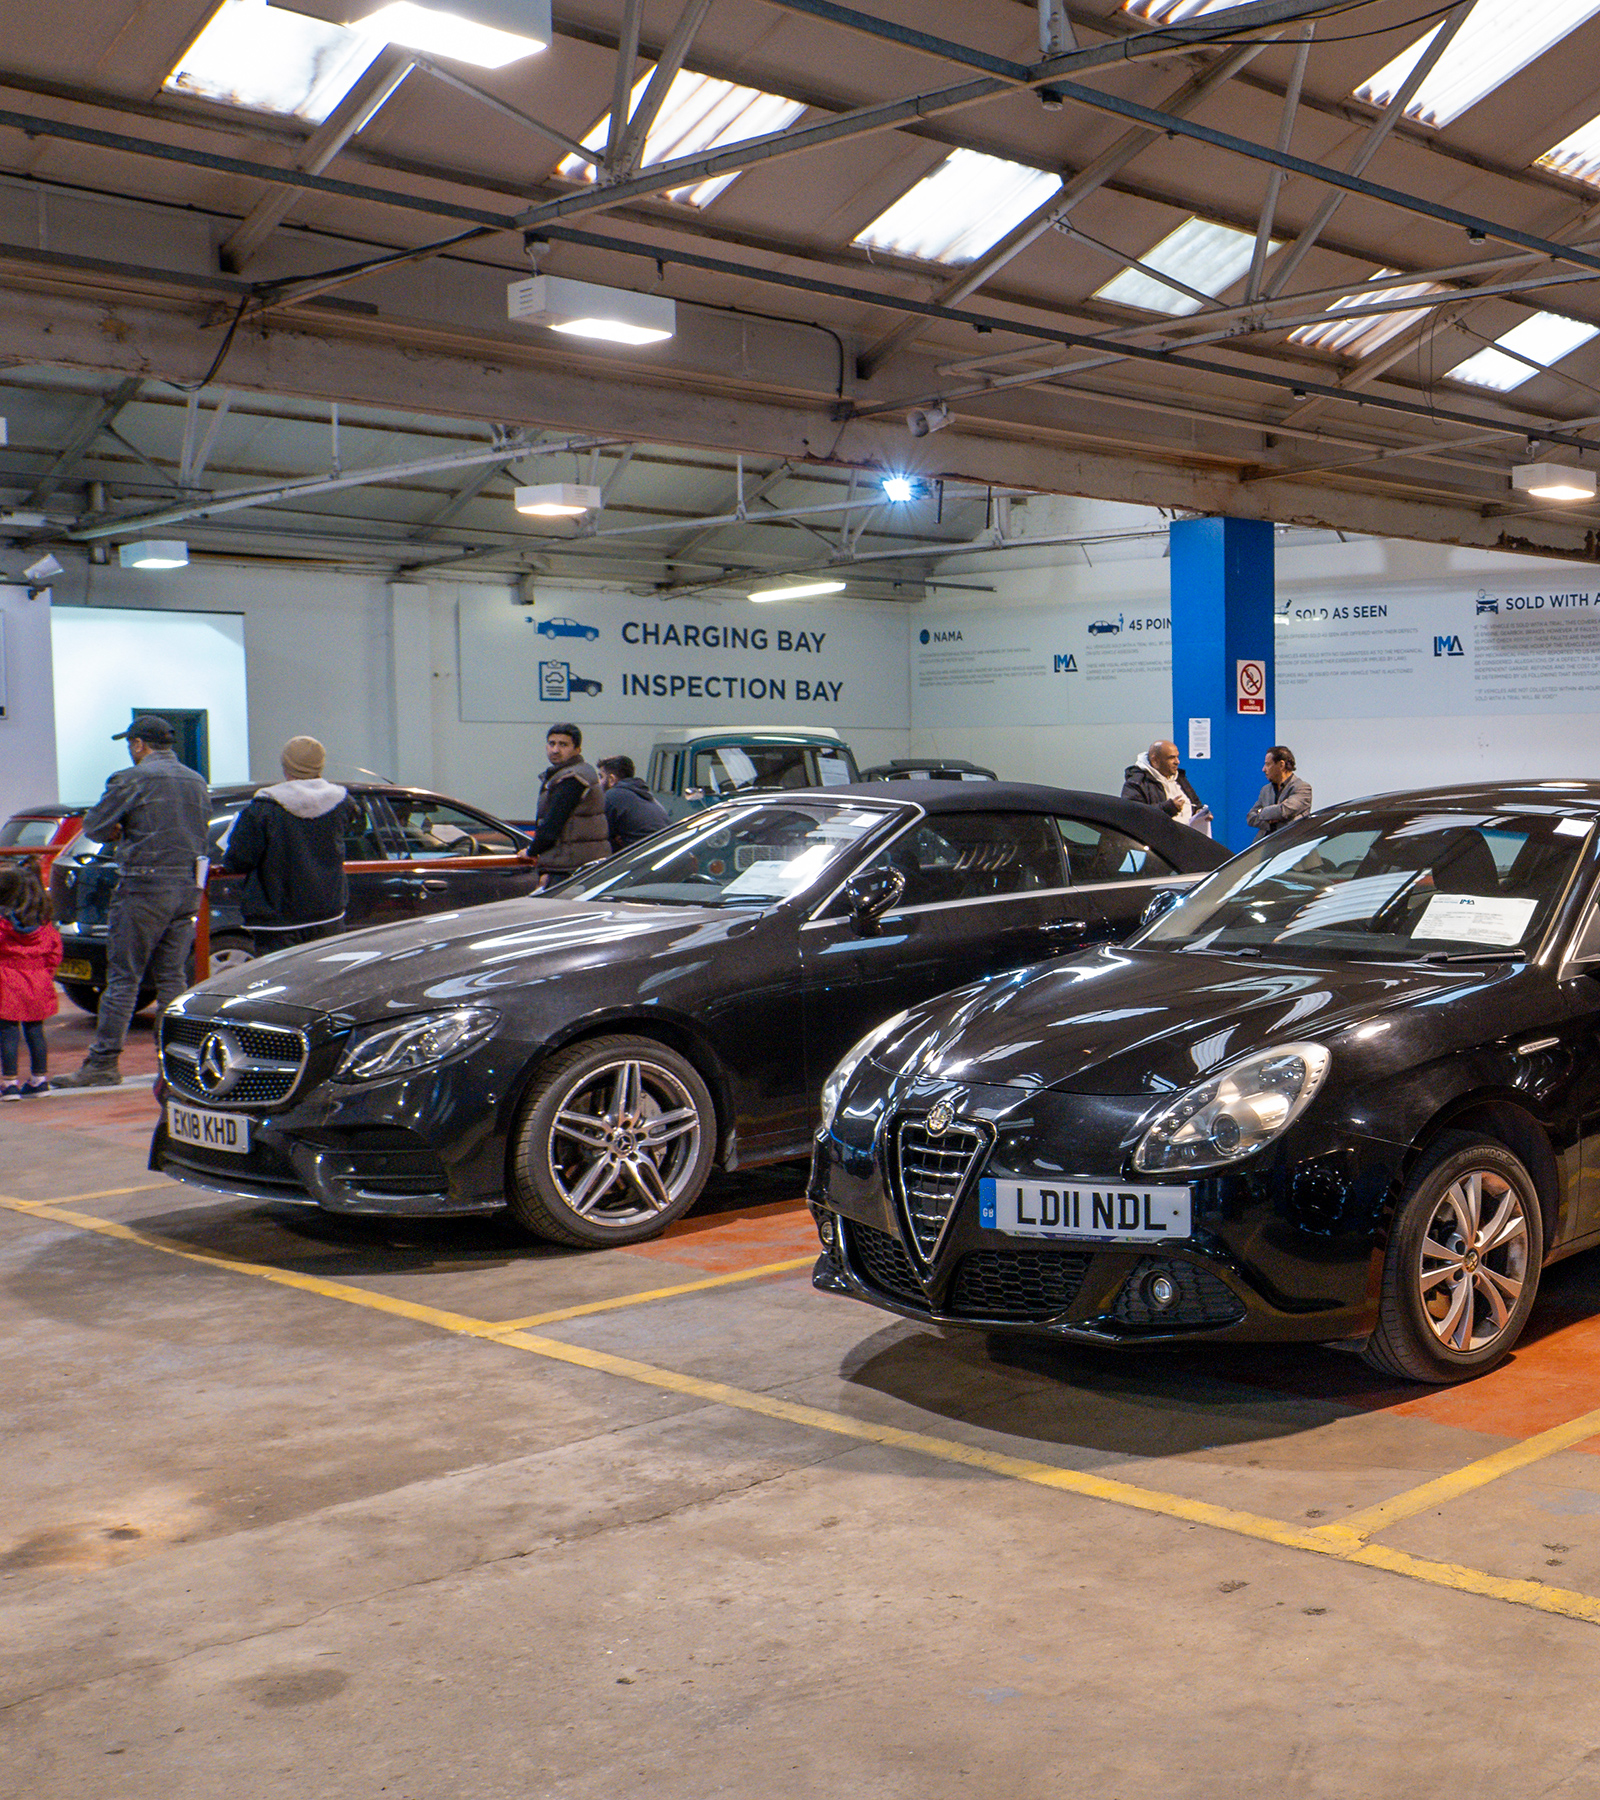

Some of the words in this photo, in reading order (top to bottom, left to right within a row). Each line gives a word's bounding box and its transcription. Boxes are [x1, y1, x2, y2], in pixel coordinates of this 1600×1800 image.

[1506, 596, 1544, 610] SOLD
[1550, 593, 1588, 608] WITH
[1296, 608, 1328, 622] SOLD
[1332, 607, 1349, 620] AS
[1353, 604, 1388, 618] SEEN
[1129, 620, 1142, 630] 45
[622, 622, 768, 650] CHARGING
[777, 630, 826, 653] BAY
[933, 631, 963, 643] NAMA
[1434, 635, 1464, 657] LMA
[1054, 654, 1078, 673] LMA
[622, 674, 786, 700] INSPECTION
[796, 680, 843, 702] BAY
[173, 1108, 200, 1138] EK18
[204, 1114, 237, 1146] KHD
[982, 1208, 994, 1218] GB
[1016, 1188, 1080, 1228] LD11
[1092, 1192, 1167, 1230] NDL
